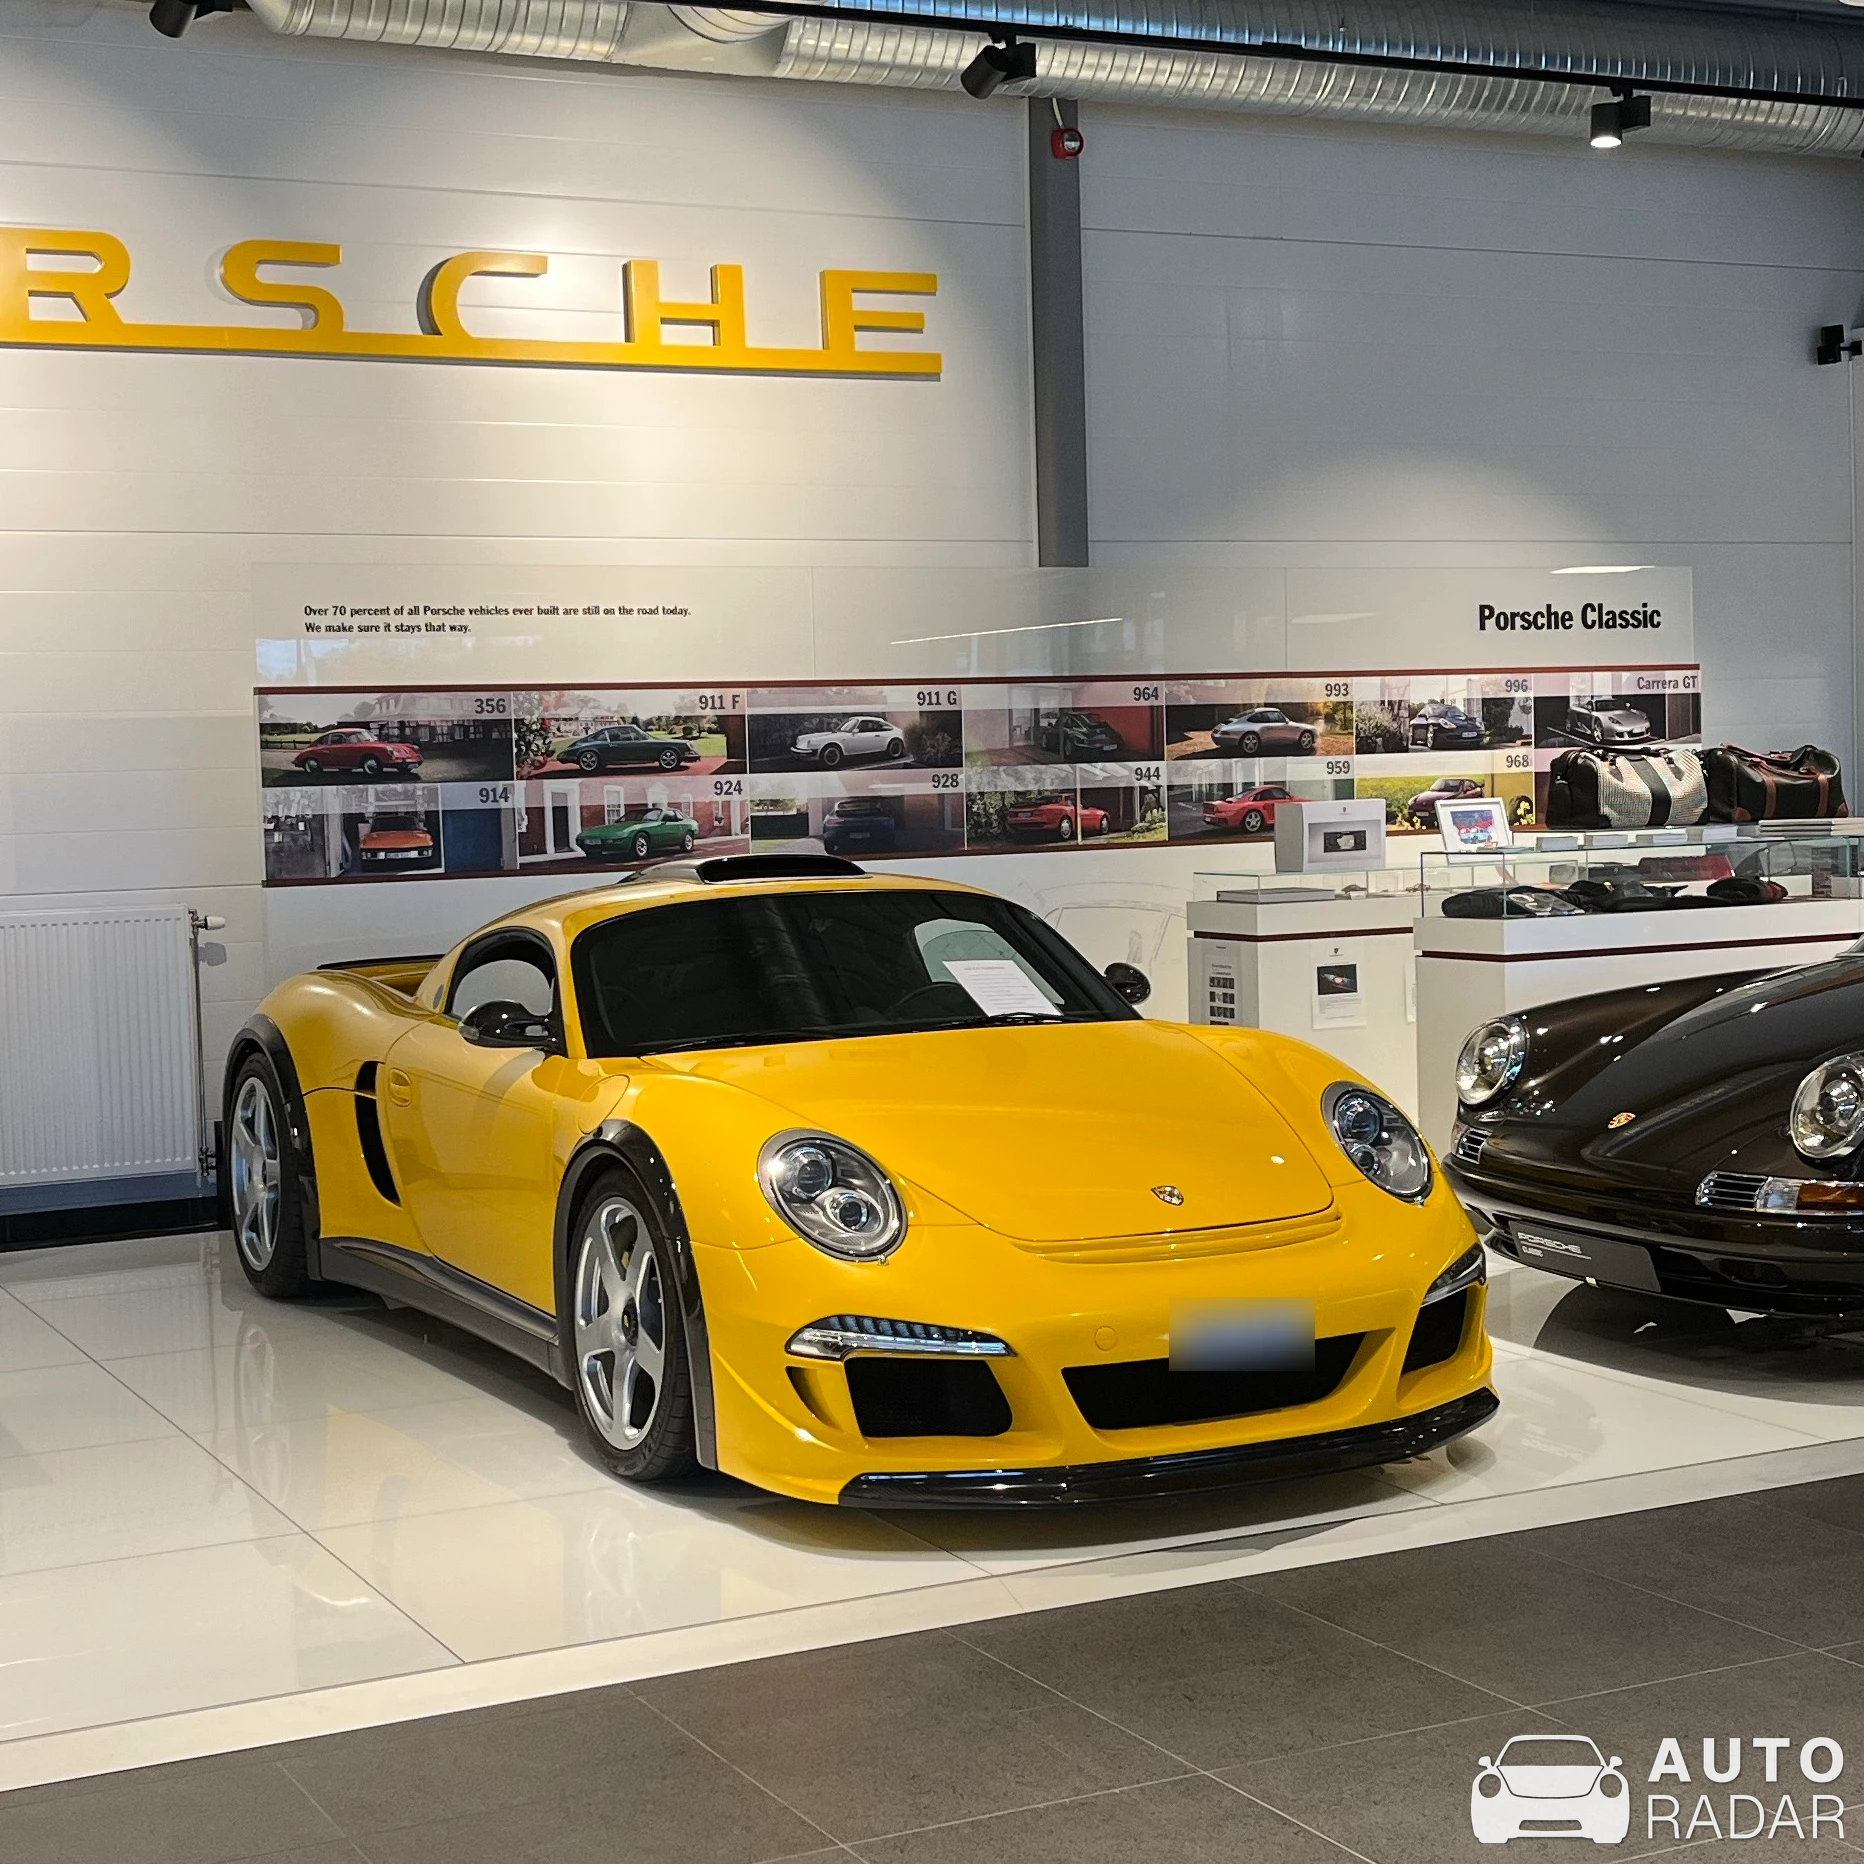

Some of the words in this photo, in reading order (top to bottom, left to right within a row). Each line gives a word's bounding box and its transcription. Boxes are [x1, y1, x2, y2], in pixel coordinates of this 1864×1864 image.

[304, 605, 329, 616] Over
[332, 605, 347, 616] 70
[350, 605, 391, 618] percent
[394, 605, 404, 616] of
[407, 605, 420, 616] all
[423, 605, 466, 616] Porsche
[468, 605, 510, 616] vehicles
[512, 607, 534, 616] ever
[537, 605, 560, 616] built
[562, 607, 579, 616] are
[582, 605, 600, 616] still
[603, 607, 616, 616] on
[618, 605, 635, 616] the
[637, 605, 660, 616] road
[662, 605, 692, 618] today.
[1478, 603, 1574, 631] Porsche
[1581, 602, 1662, 630] Classic
[304, 621, 322, 633] We
[325, 622, 354, 633] make
[357, 624, 381, 633] sure
[384, 622, 392, 633] it
[394, 622, 422, 635] stays
[424, 622, 447, 633] that
[449, 624, 472, 634] way.
[1324, 682, 1350, 698] 993
[1504, 679, 1529, 693] 996
[1636, 675, 1680, 690] Carrera
[1682, 675, 1698, 689] GT
[916, 690, 943, 706] 911
[947, 690, 958, 706] G
[1132, 686, 1160, 702] 964
[474, 698, 507, 715] 356
[698, 694, 726, 711] 911
[731, 694, 741, 710] F
[1326, 760, 1351, 775] 959
[1505, 755, 1530, 769] 968
[931, 773, 960, 790] 928
[1134, 766, 1161, 782] 944
[479, 786, 510, 804] 914
[713, 780, 744, 797] 924
